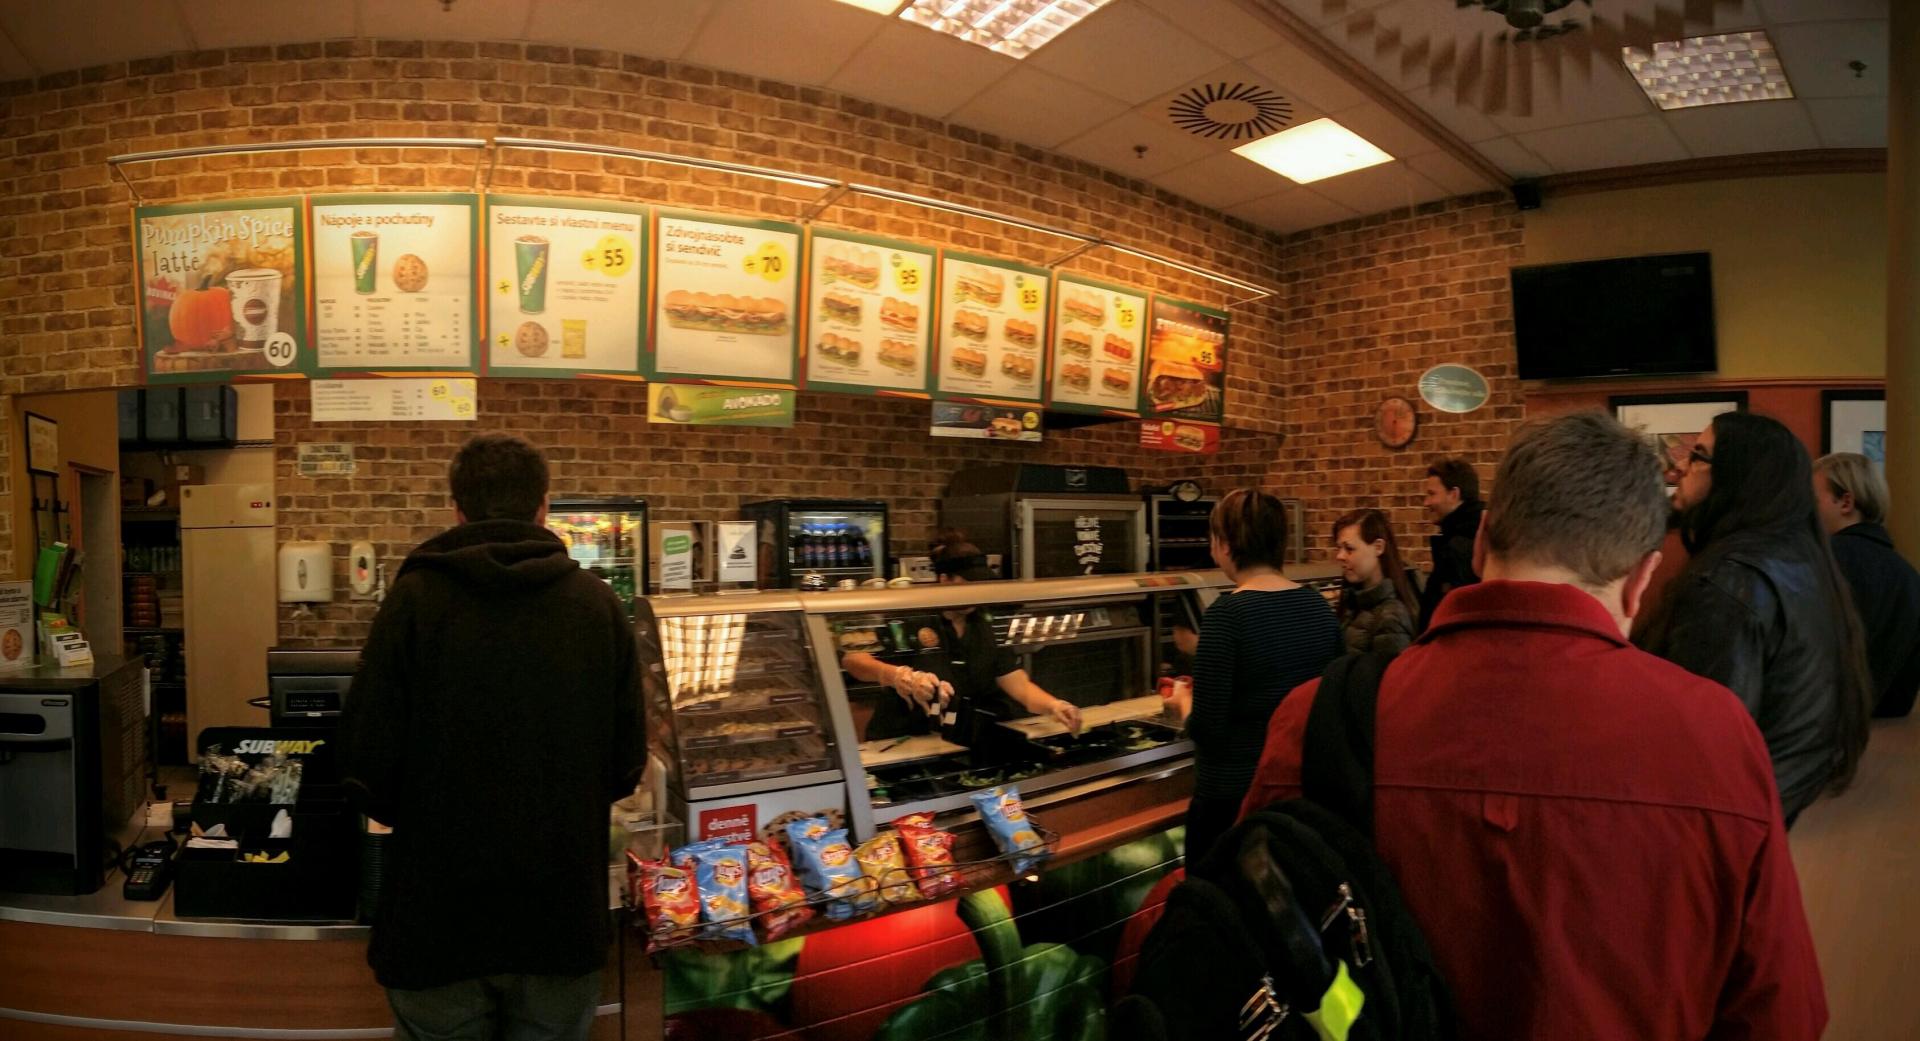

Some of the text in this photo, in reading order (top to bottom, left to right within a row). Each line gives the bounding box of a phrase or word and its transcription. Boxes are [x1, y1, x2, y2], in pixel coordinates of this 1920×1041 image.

[320, 214, 363, 228] Nápoje
[496, 213, 547, 227] Sestavte
[549, 215, 557, 227] si
[599, 221, 635, 232] menu
[142, 212, 296, 253] Pumpkin Spice
[665, 224, 745, 245] Zdvojnásobte
[665, 241, 675, 253] si
[152, 250, 201, 277] latte
[603, 248, 625, 267] 55
[762, 256, 783, 273] 70
[901, 269, 917, 285] 95
[1022, 289, 1039, 305] 85
[1121, 309, 1134, 323] 75
[269, 340, 292, 359] 60
[1200, 351, 1212, 364] 95
[231, 739, 326, 754] SUBWAY
[708, 814, 749, 831] denně
